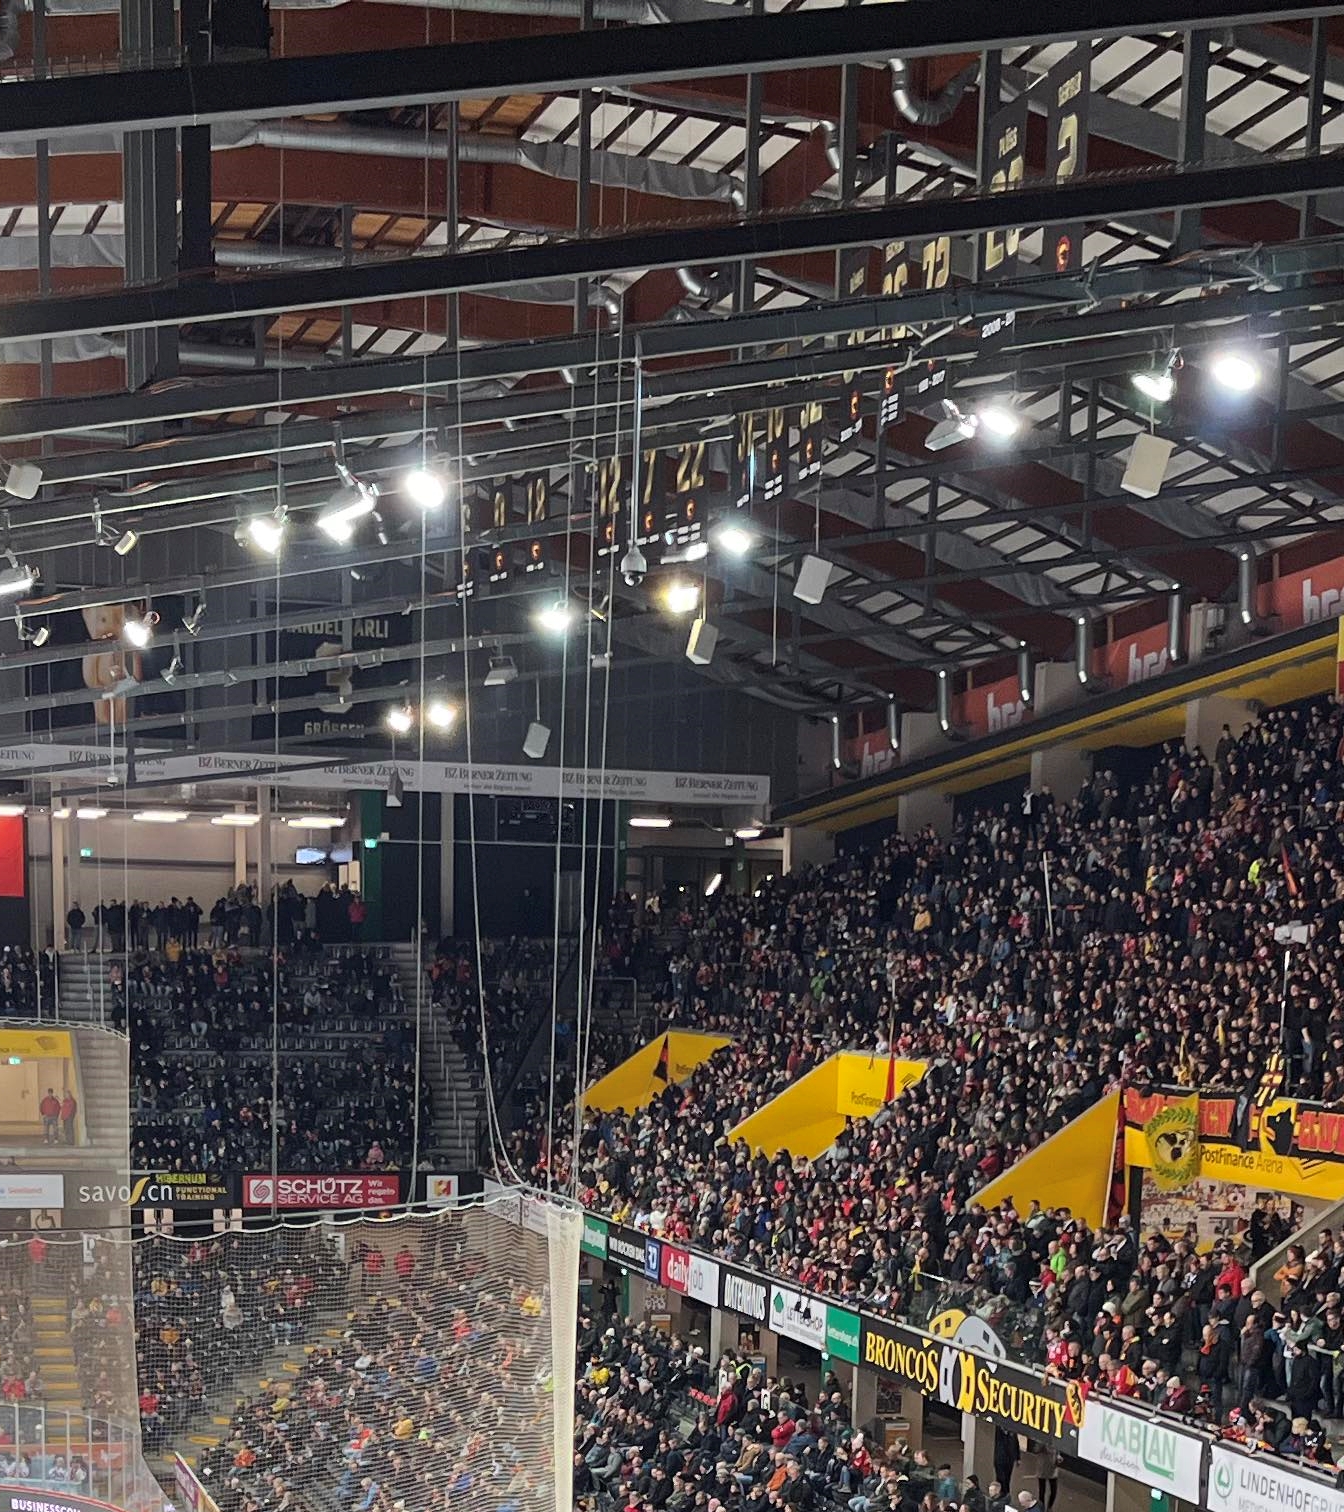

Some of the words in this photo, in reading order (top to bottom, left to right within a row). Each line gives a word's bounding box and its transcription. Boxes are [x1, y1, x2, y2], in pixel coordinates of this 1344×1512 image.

[69, 751, 83, 762] BZ
[198, 757, 212, 768] BZ
[445, 767, 458, 778] BZ
[494, 769, 531, 781] ZEITUNG
[562, 773, 576, 783] BZ
[610, 776, 646, 786] ZEITUNG
[675, 777, 688, 788] BZ
[723, 779, 759, 791] ZEITUNG
[1256, 1151, 1284, 1174] Arena
[277, 1178, 364, 1194] SCHÜTZ
[277, 1194, 341, 1205] SERVICE
[343, 1194, 364, 1204] AG
[865, 1330, 938, 1393] BRONCOS
[976, 1367, 1067, 1440] SECURITY
[1100, 1406, 1177, 1481] KABLAN
